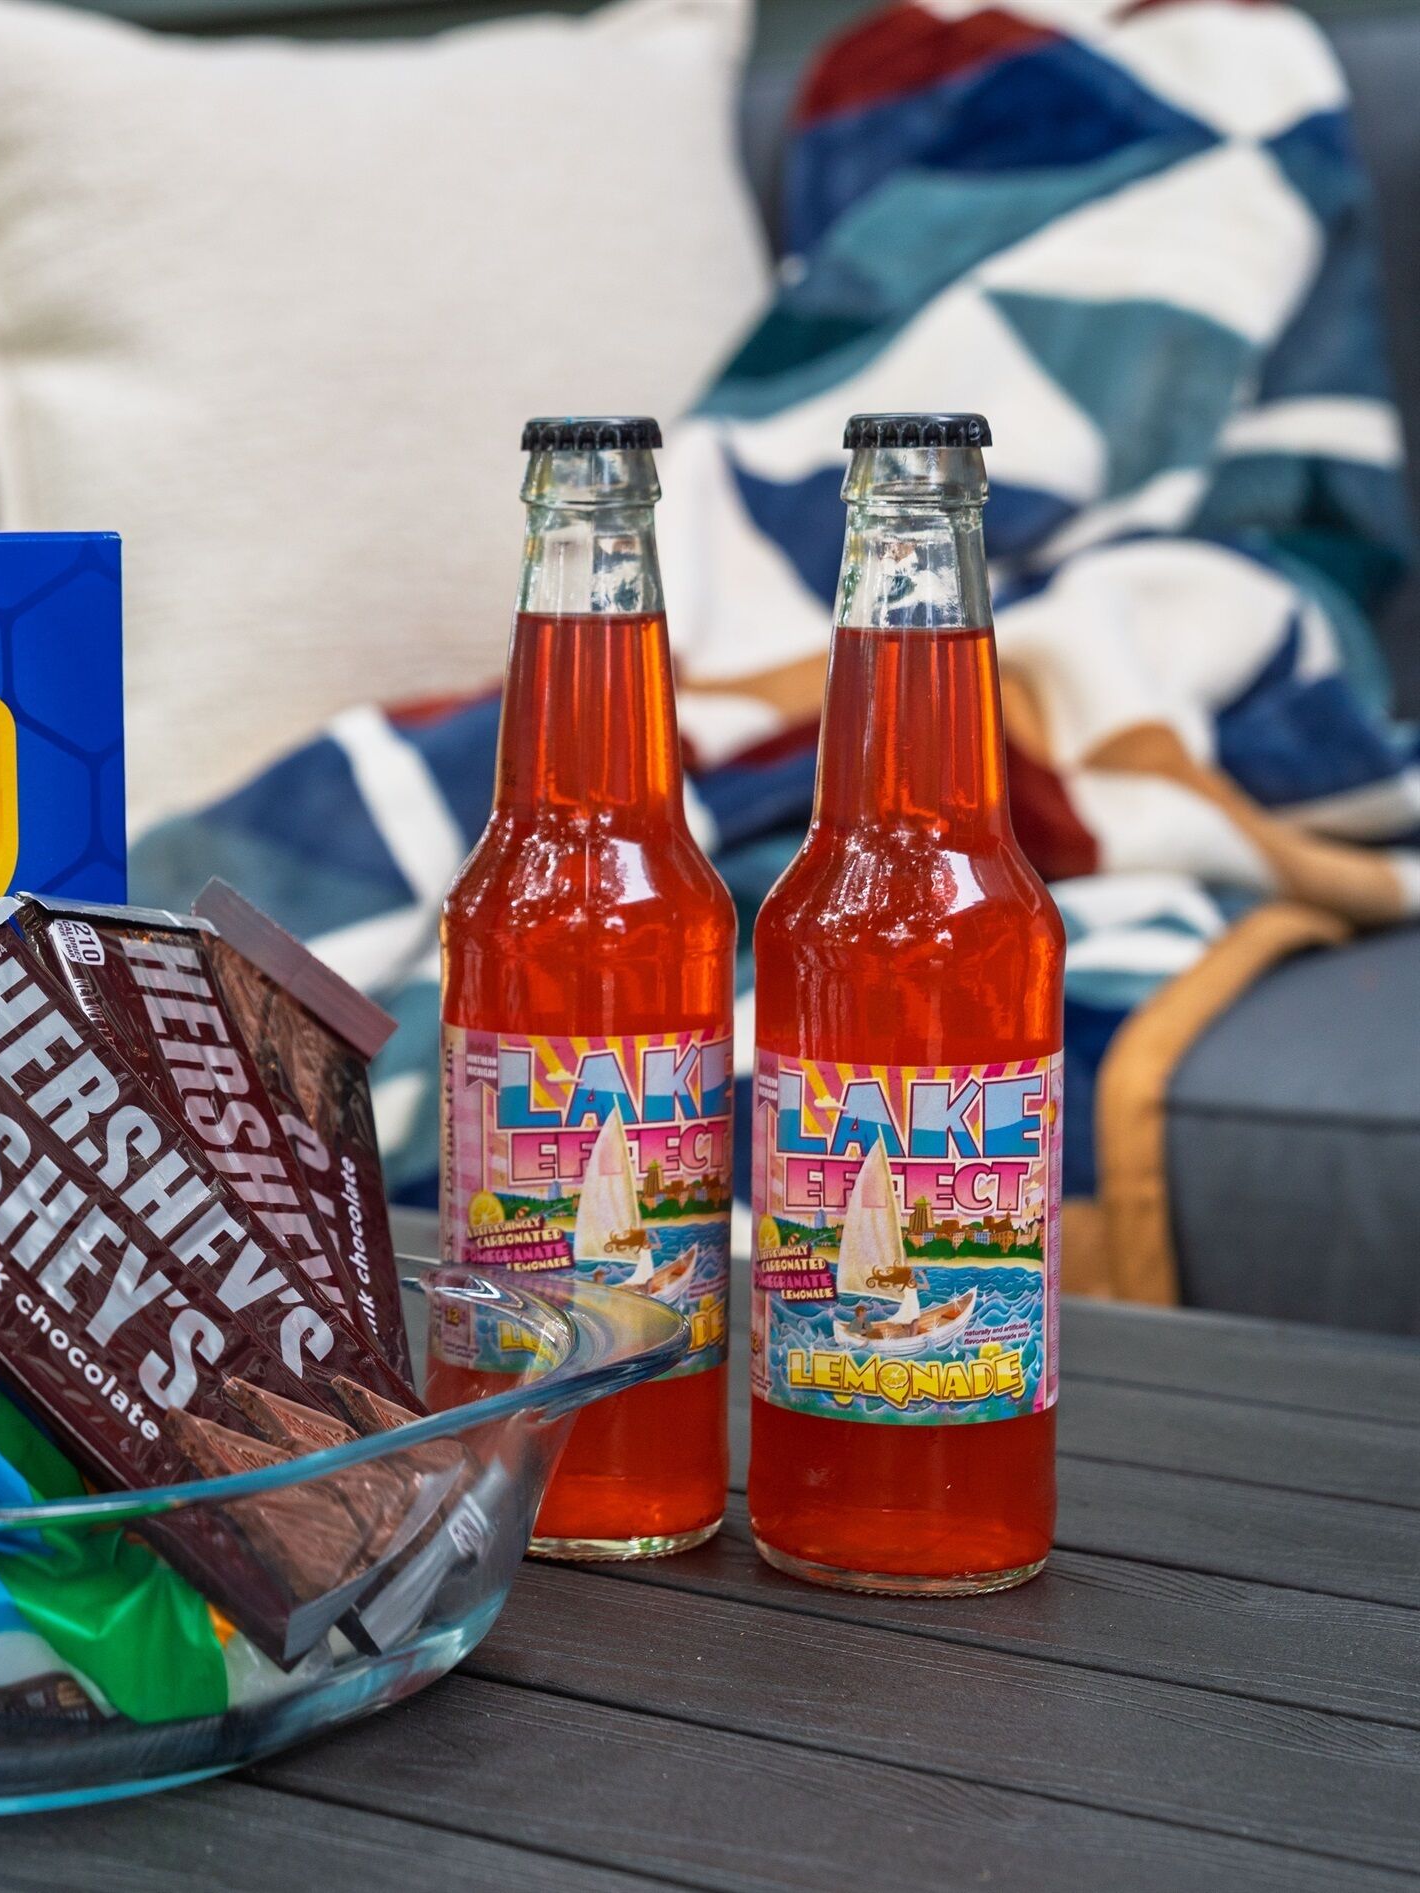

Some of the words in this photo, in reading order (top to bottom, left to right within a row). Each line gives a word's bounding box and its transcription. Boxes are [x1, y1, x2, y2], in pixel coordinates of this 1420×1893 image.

[56, 921, 67, 938] PER
[65, 943, 76, 959] BAR
[62, 919, 84, 963] CALORIES
[73, 924, 101, 963] 210
[777, 1069, 1042, 1158] LAKE
[341, 1156, 371, 1286] chocolate
[476, 1228, 562, 1249] CARBONATED
[461, 1241, 569, 1264] POMEGRANATE
[761, 1257, 827, 1273] CARBONATED
[358, 1289, 380, 1335] ilk
[780, 1287, 835, 1300] LEMONADE
[15, 1293, 161, 1442] chocolate
[789, 1351, 1023, 1407] LEMONADE
